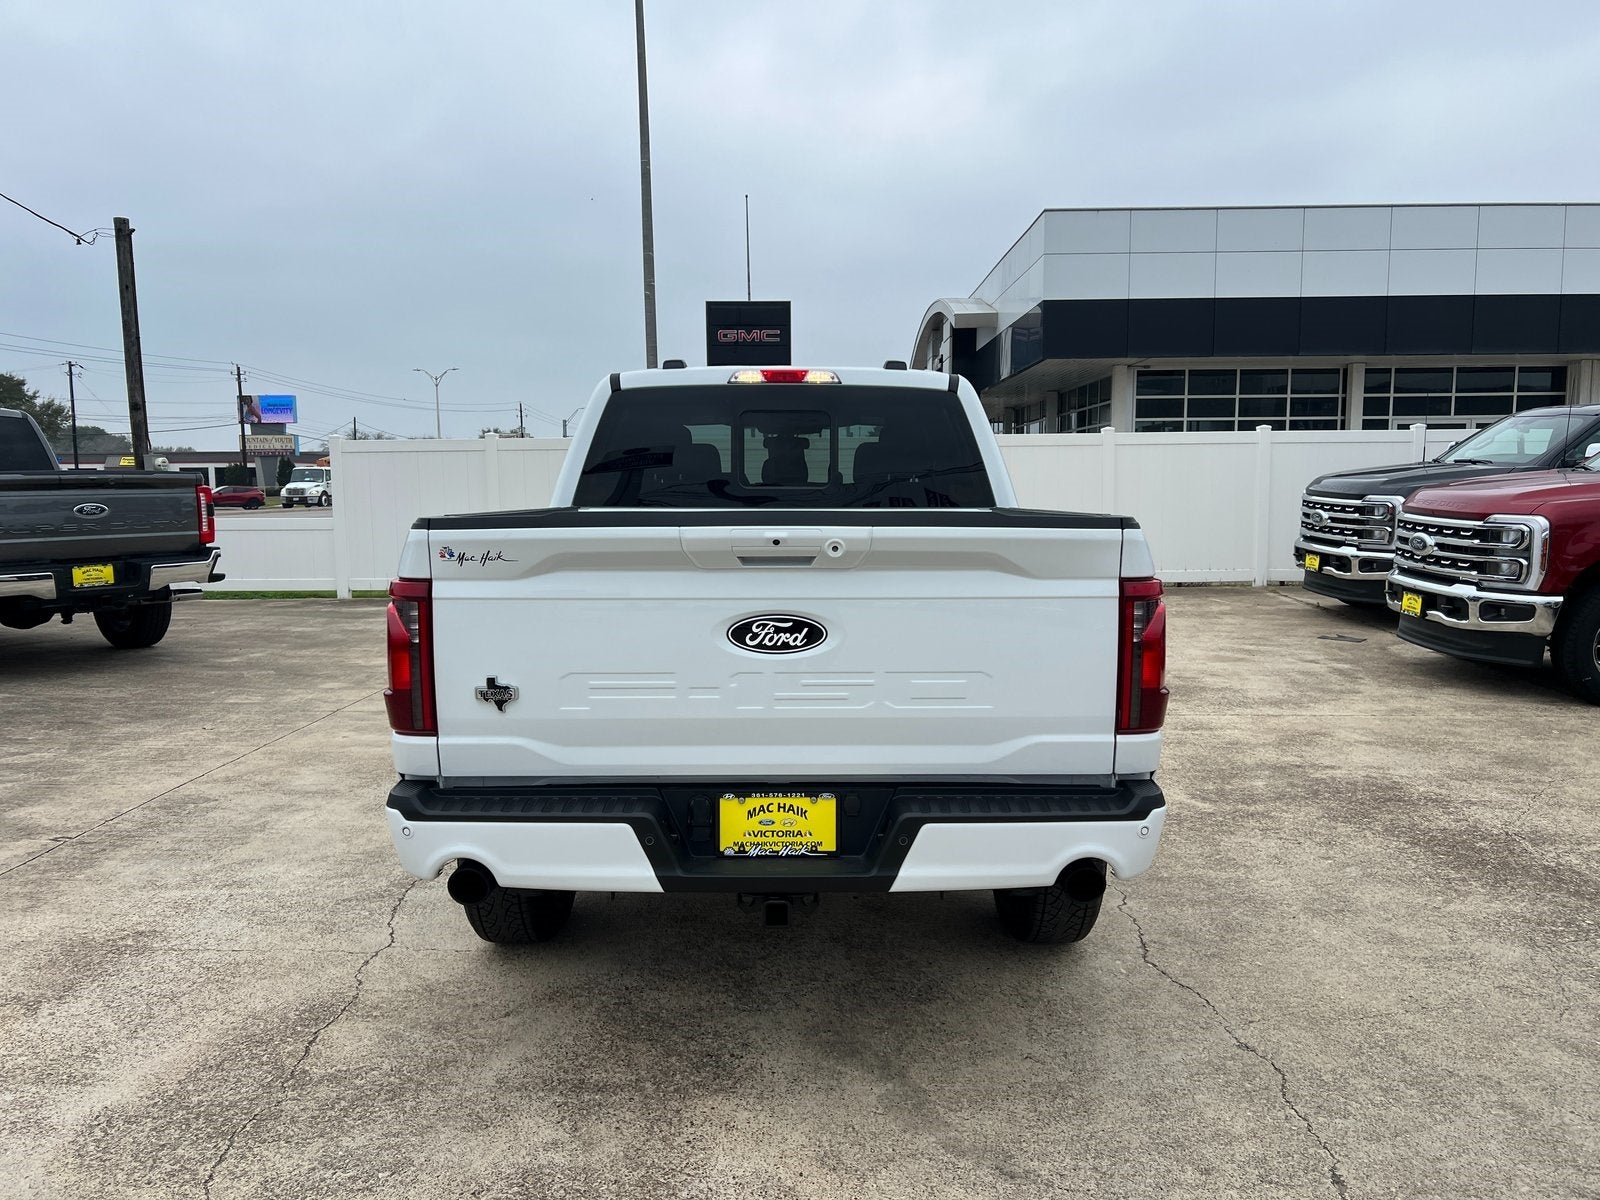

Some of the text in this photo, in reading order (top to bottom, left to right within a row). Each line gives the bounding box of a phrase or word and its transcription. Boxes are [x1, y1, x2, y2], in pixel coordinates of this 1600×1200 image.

[717, 329, 781, 342] GMC
[82, 505, 101, 514] Ford
[455, 550, 509, 567] Mac Haik
[745, 620, 809, 646] Ford
[478, 689, 513, 698] TEXAS
[746, 802, 809, 821] MAC HAIK
[752, 830, 803, 838] VICTORIA
[746, 845, 815, 857] Mac Haik
